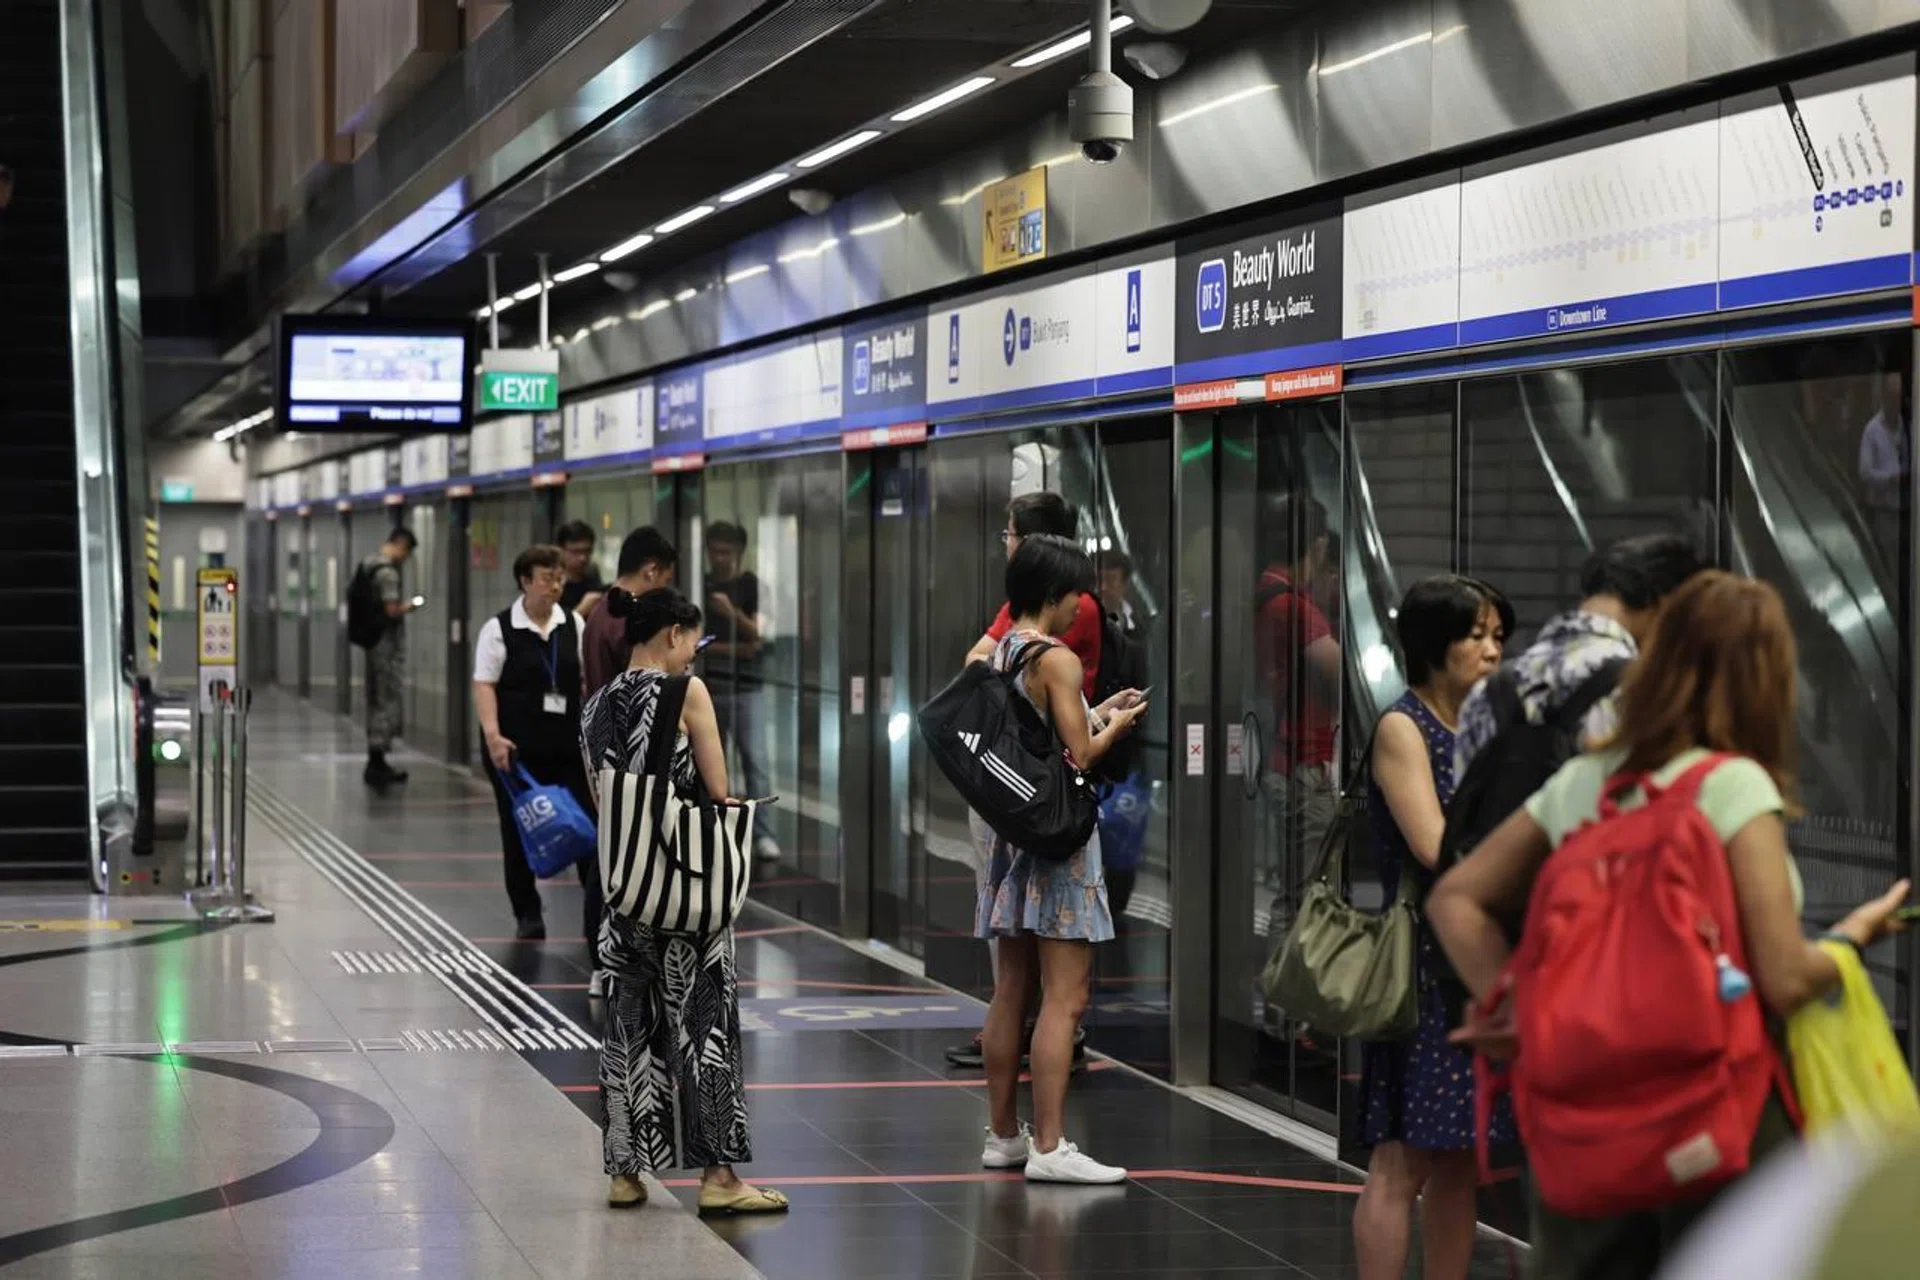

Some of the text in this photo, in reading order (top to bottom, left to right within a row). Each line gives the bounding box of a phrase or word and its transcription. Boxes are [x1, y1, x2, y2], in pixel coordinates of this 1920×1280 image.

[1232, 230, 1315, 291] Beauty World
[1129, 283, 1139, 325] A
[1202, 281, 1221, 311] DT 5
[1232, 299, 1260, 330] 美世界
[1560, 310, 1591, 327] Downtown
[1593, 305, 1607, 322] Line
[502, 377, 548, 404] EXIT
[516, 794, 553, 826] BIG
